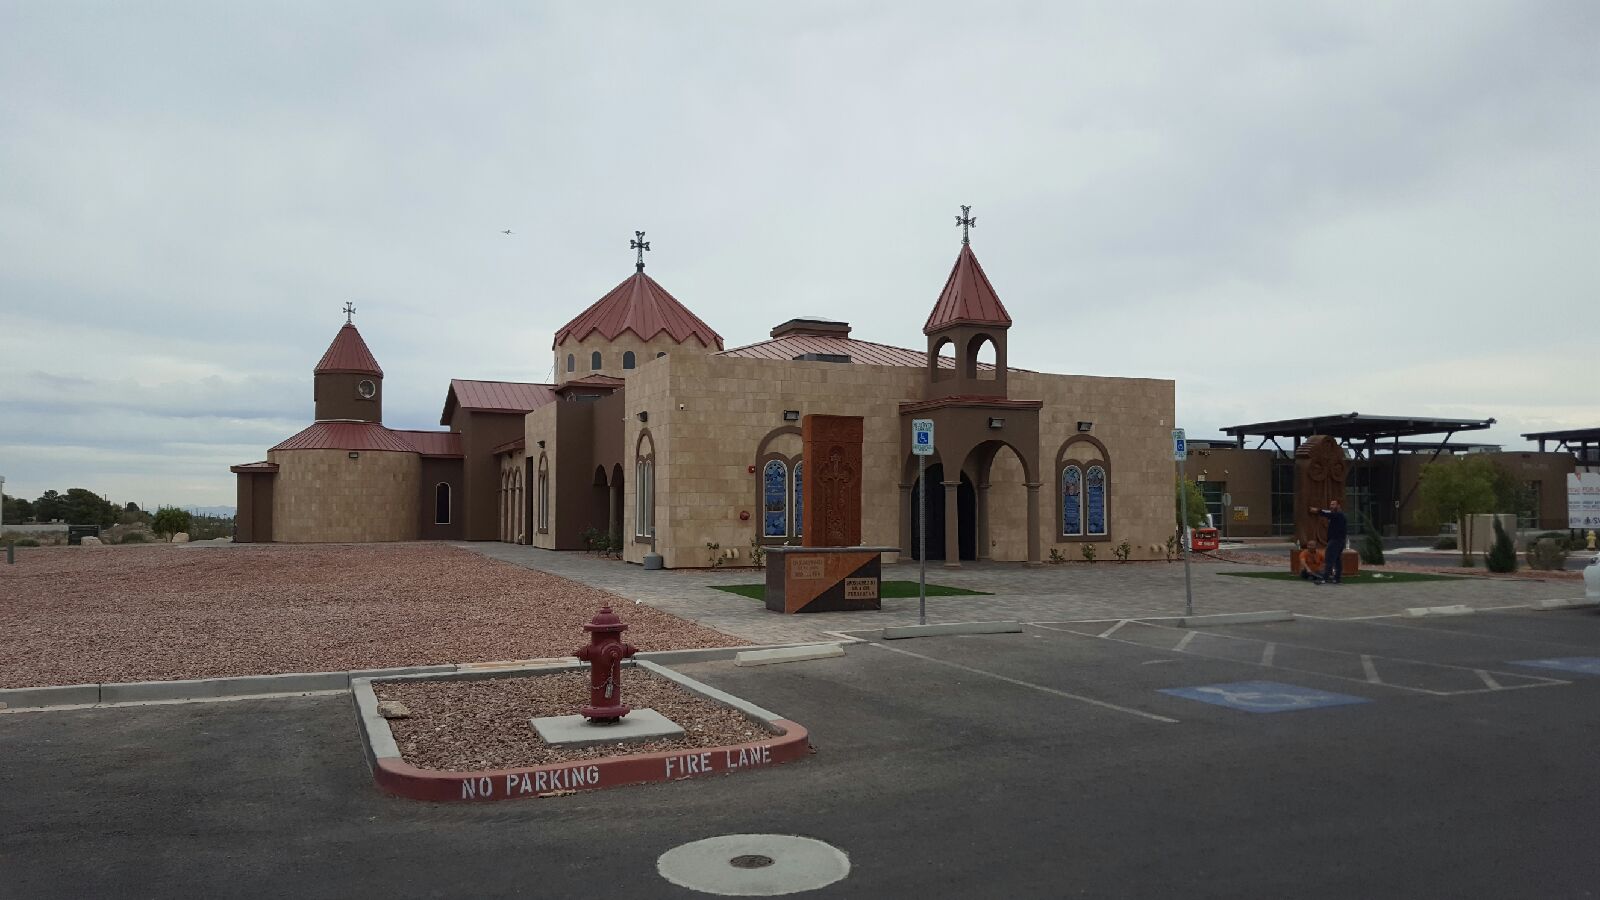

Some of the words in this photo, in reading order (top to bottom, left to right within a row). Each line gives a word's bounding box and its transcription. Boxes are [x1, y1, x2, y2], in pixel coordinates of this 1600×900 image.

[665, 752, 712, 778] FIRE
[726, 744, 772, 768] LANE
[462, 777, 493, 799] NO
[506, 765, 599, 796] PARKING
